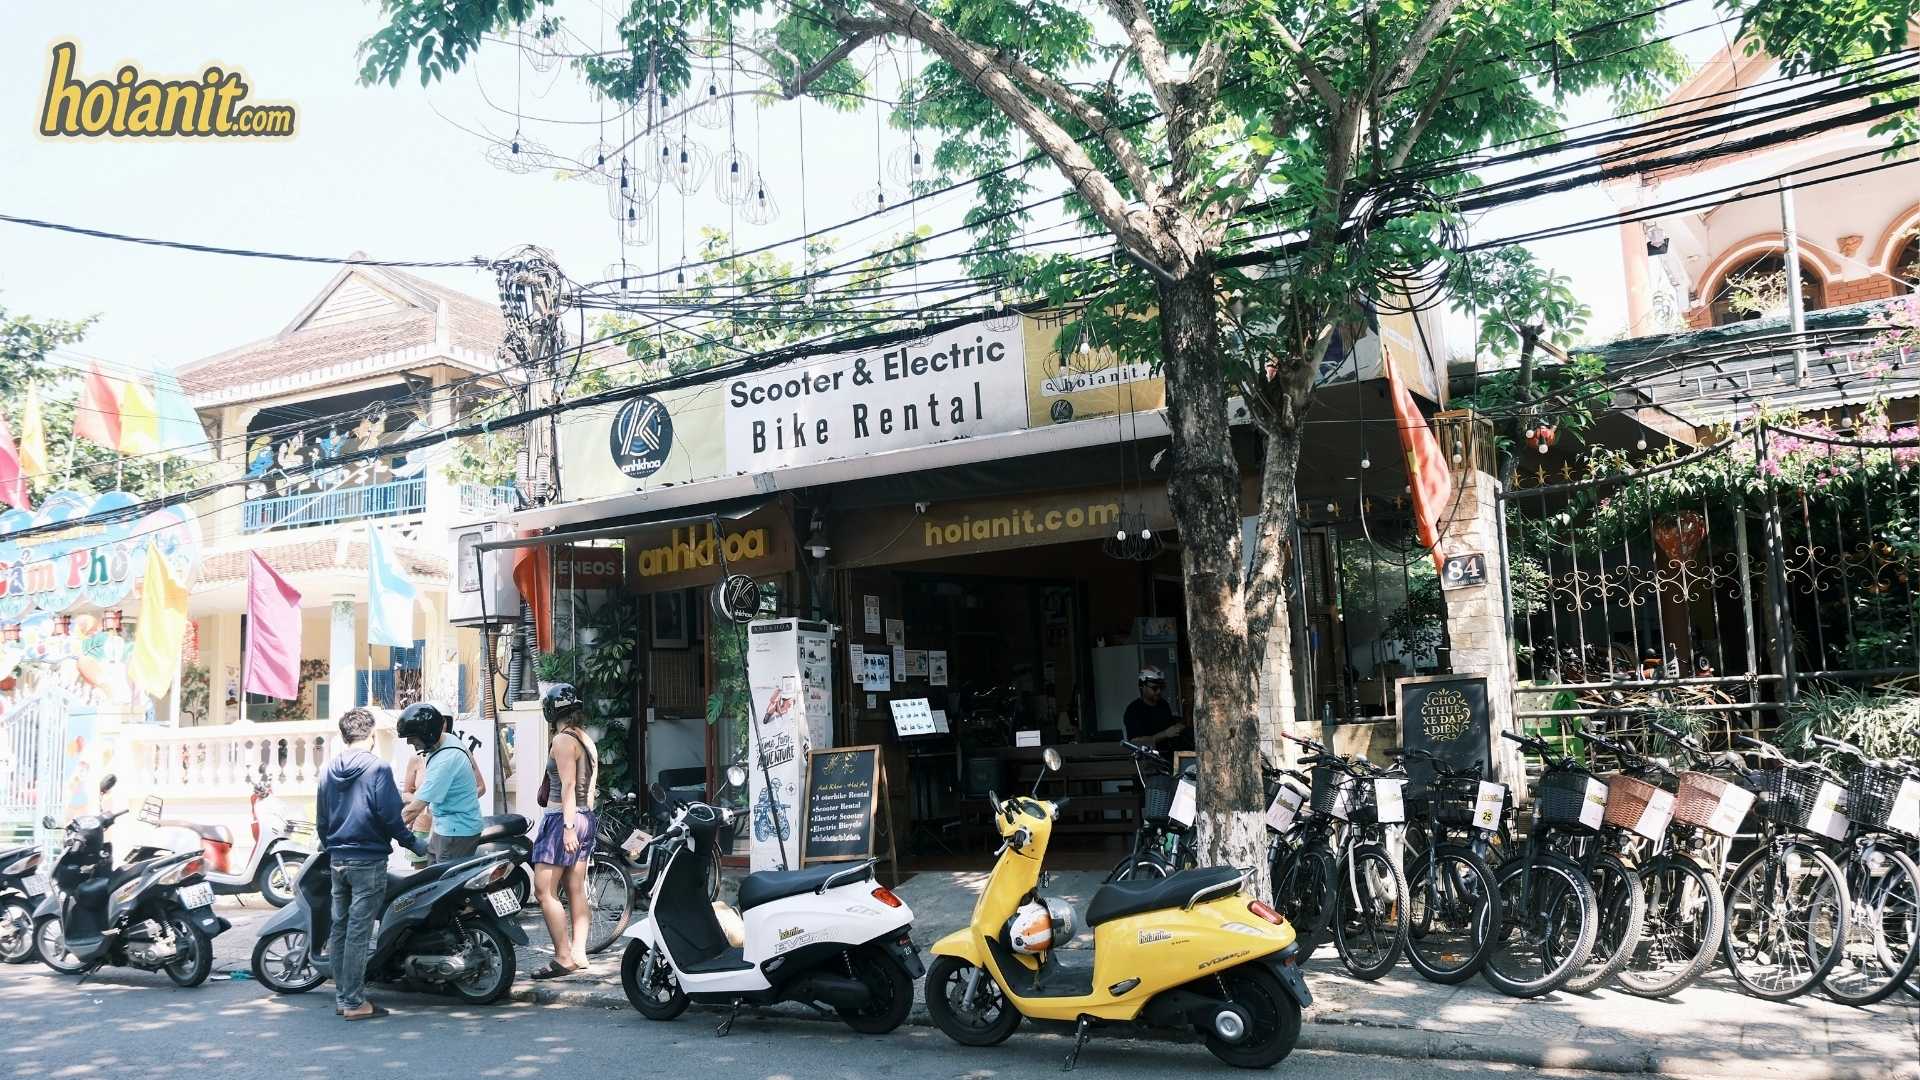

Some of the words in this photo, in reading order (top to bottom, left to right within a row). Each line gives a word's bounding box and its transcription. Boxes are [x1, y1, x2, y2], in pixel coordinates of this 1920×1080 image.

[730, 369, 844, 408] Scooter
[852, 357, 874, 386] &
[884, 335, 1005, 381] Electric
[752, 412, 829, 454] Bike
[853, 381, 983, 439] Rental
[622, 458, 661, 474] anhkhoa
[925, 502, 1121, 546] hoianit.com
[638, 523, 766, 577] anhkhoa
[558, 560, 616, 576] ENEOS
[1447, 556, 1481, 580] 84
[1431, 695, 1457, 706] CHO
[1423, 716, 1438, 725] XE
[1482, 811, 1493, 822] 25
